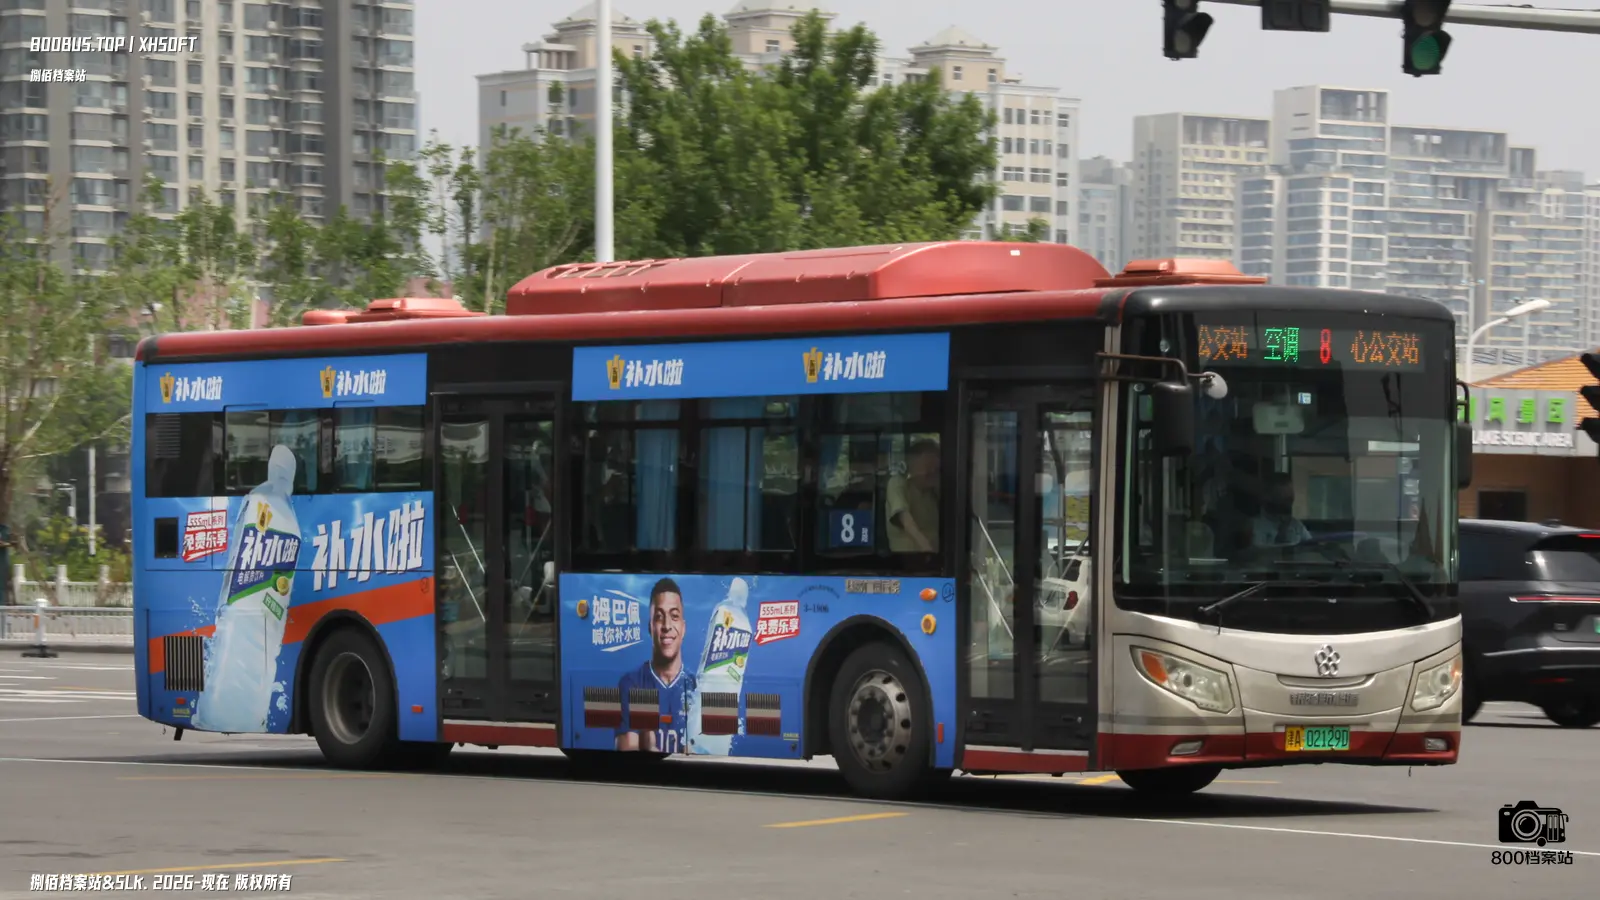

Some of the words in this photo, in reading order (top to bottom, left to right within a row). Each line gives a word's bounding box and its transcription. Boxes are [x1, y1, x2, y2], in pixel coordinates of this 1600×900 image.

[1264, 327, 1300, 362] 空调
[1319, 328, 1332, 364] 8
[1350, 330, 1421, 366] 心公交站
[625, 359, 684, 387] 补水啦
[824, 351, 887, 381] 补水啦
[175, 376, 223, 402] 补水啦
[336, 369, 387, 396] 补水啦
[840, 513, 855, 543] 8
[182, 529, 227, 556] 免费乐享
[240, 530, 299, 570] 补水啦
[311, 499, 425, 591] 补水啦
[592, 595, 640, 625] 姆巴佩
[762, 605, 796, 616] 555mL系列
[592, 627, 641, 645] 喊你补水啦
[712, 627, 751, 652] 补水啦
[755, 618, 799, 640] 免费乐享
